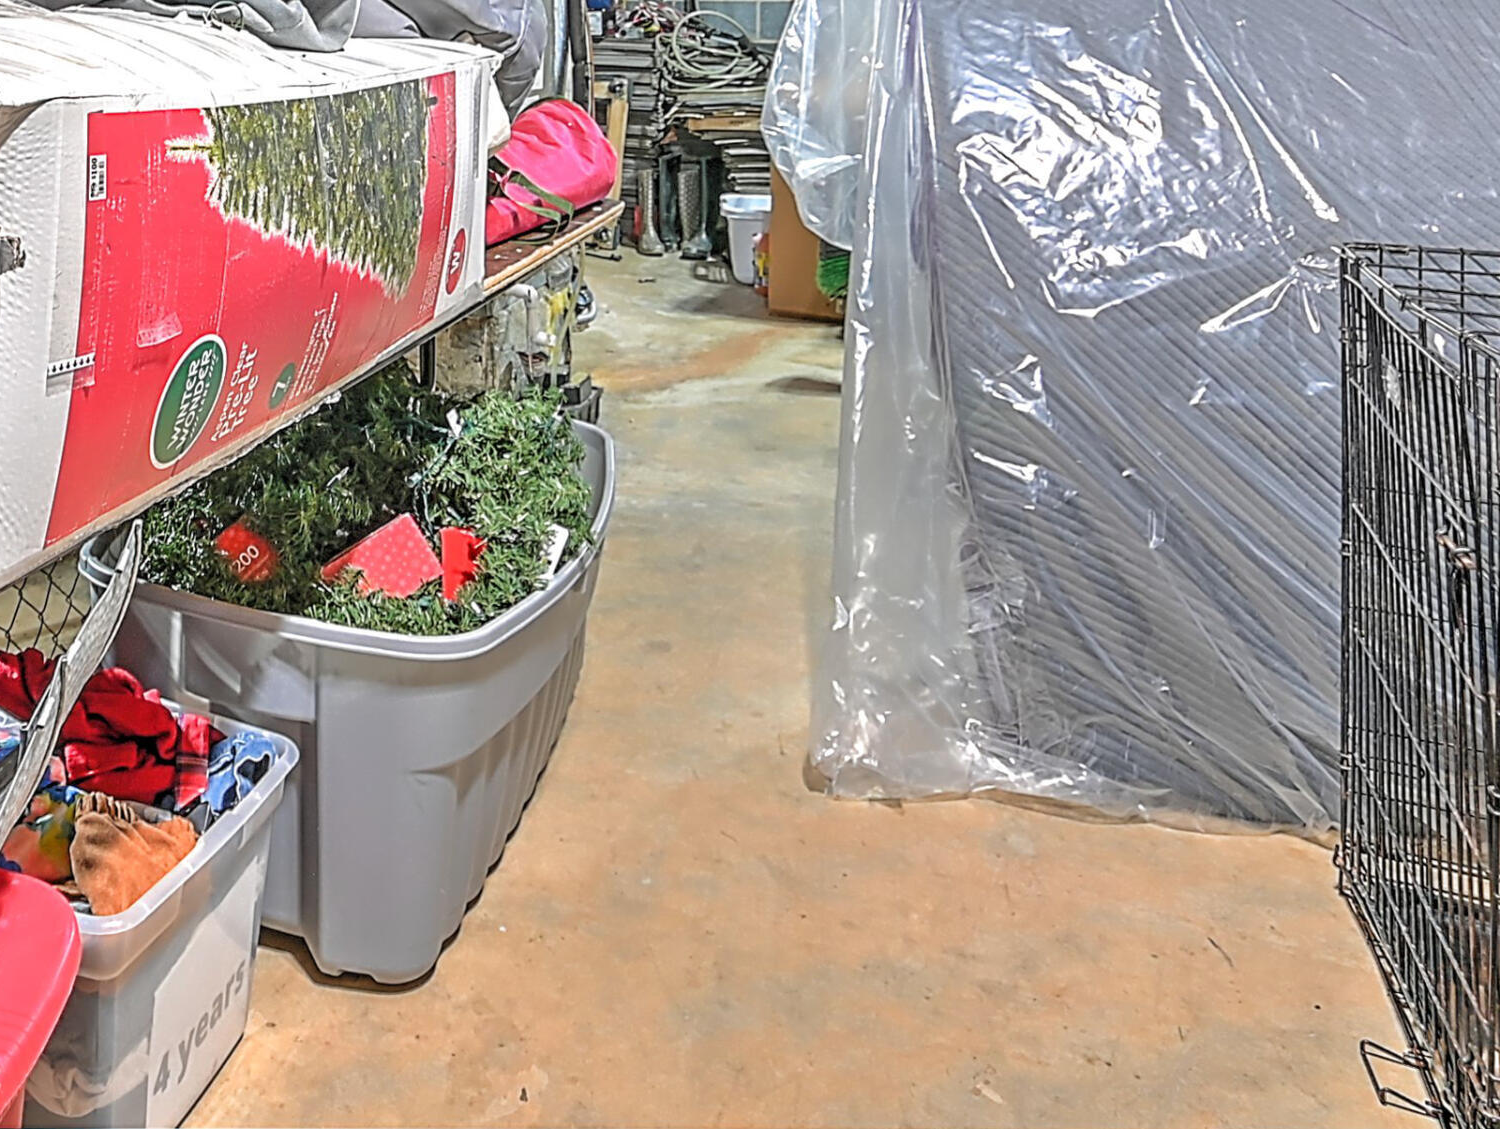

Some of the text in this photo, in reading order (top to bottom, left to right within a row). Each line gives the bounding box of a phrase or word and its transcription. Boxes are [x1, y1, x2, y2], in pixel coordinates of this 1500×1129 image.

[167, 358, 200, 450] WINTER
[175, 349, 213, 450] WONDER
[210, 341, 248, 441] Aspen Clear
[219, 348, 258, 438] Pre-Lit
[230, 374, 259, 432] Tree
[232, 545, 260, 573] 200
[153, 959, 246, 1096] 4 years
